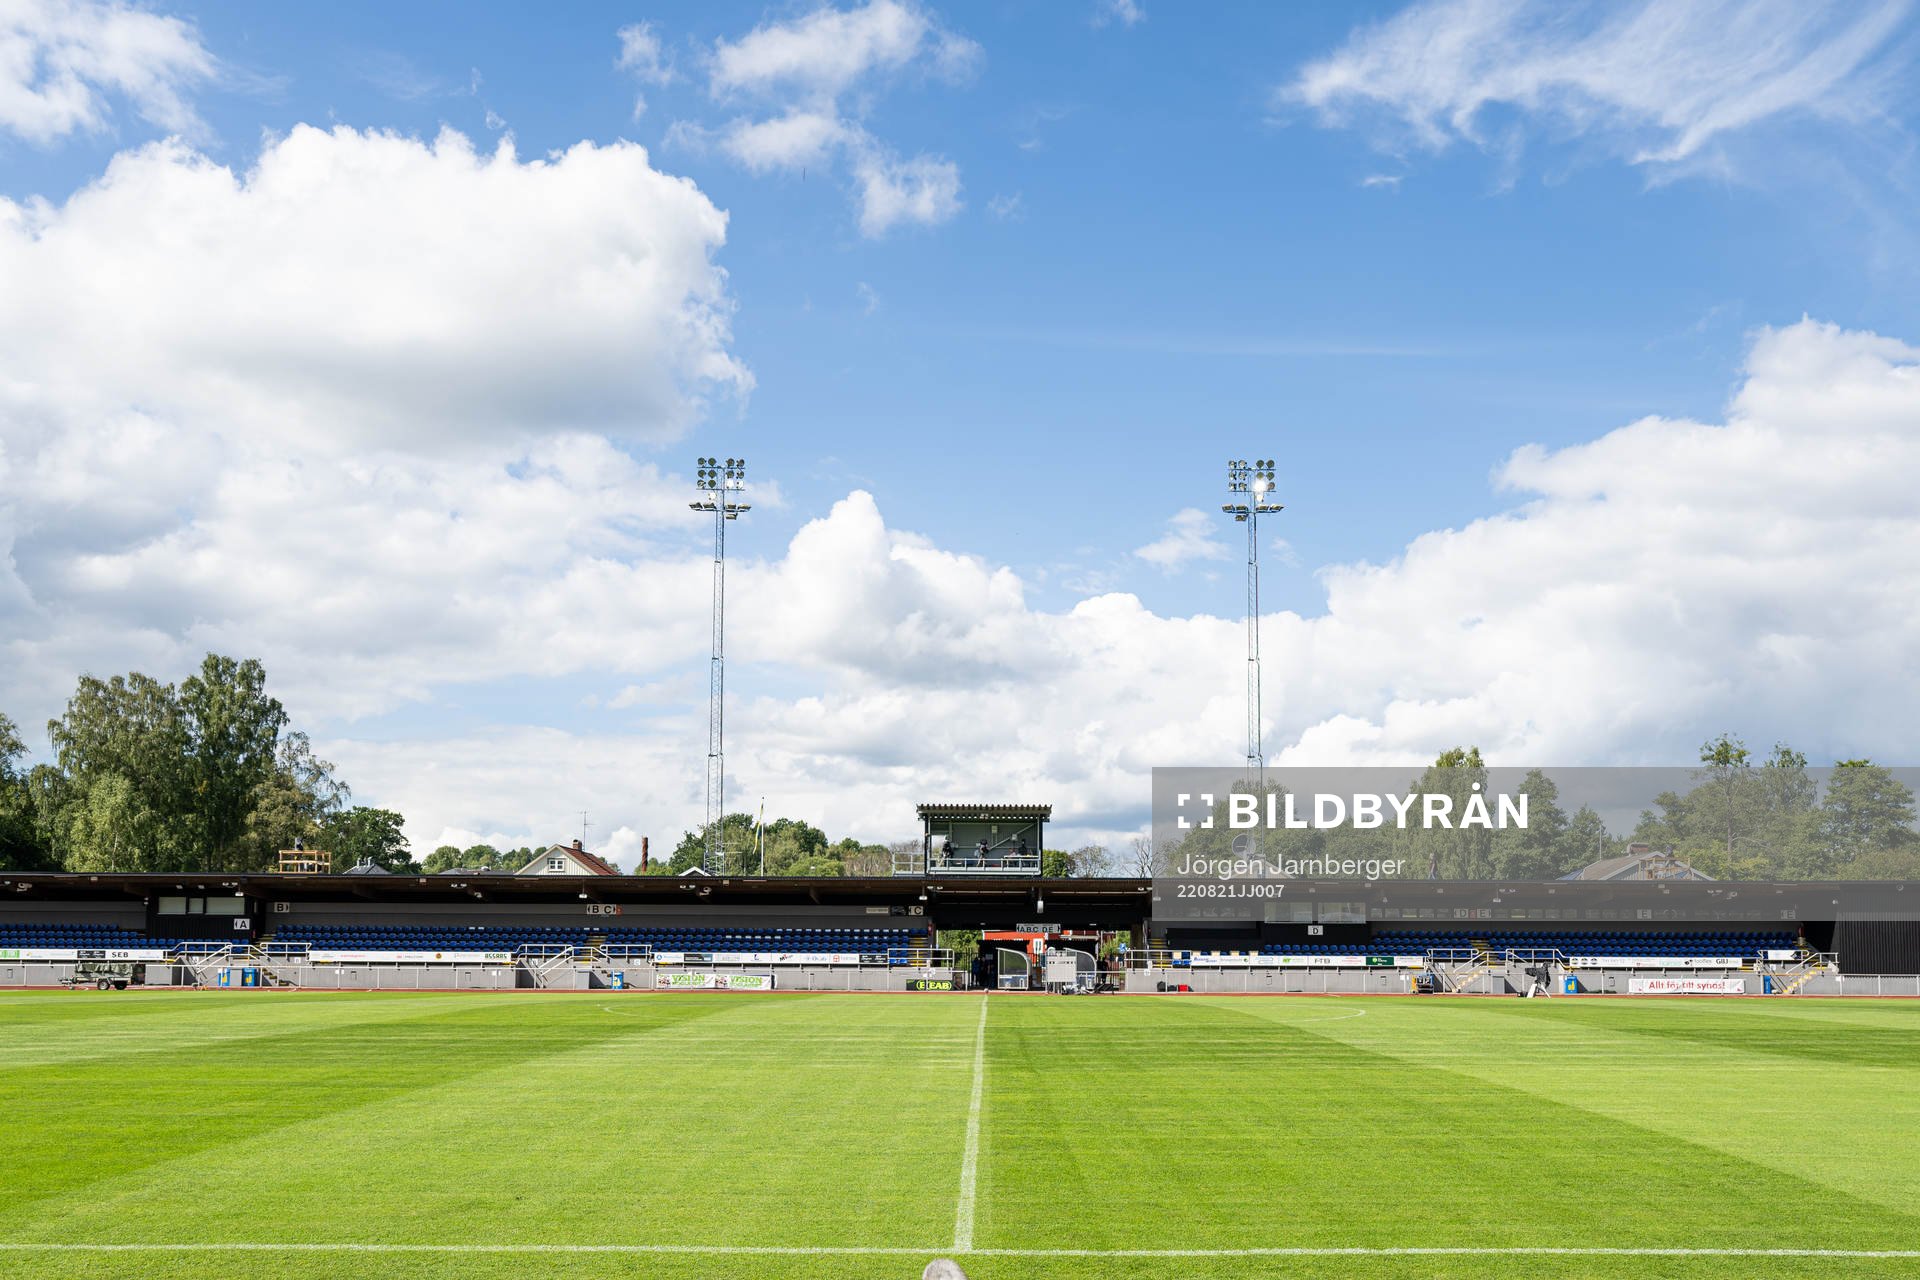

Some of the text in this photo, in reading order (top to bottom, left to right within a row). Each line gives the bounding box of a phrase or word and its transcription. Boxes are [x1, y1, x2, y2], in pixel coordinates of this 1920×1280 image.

[277, 903, 284, 912] B
[592, 906, 612, 914] B C
[914, 906, 922, 915] C
[239, 920, 247, 929] A
[1312, 927, 1319, 935] D
